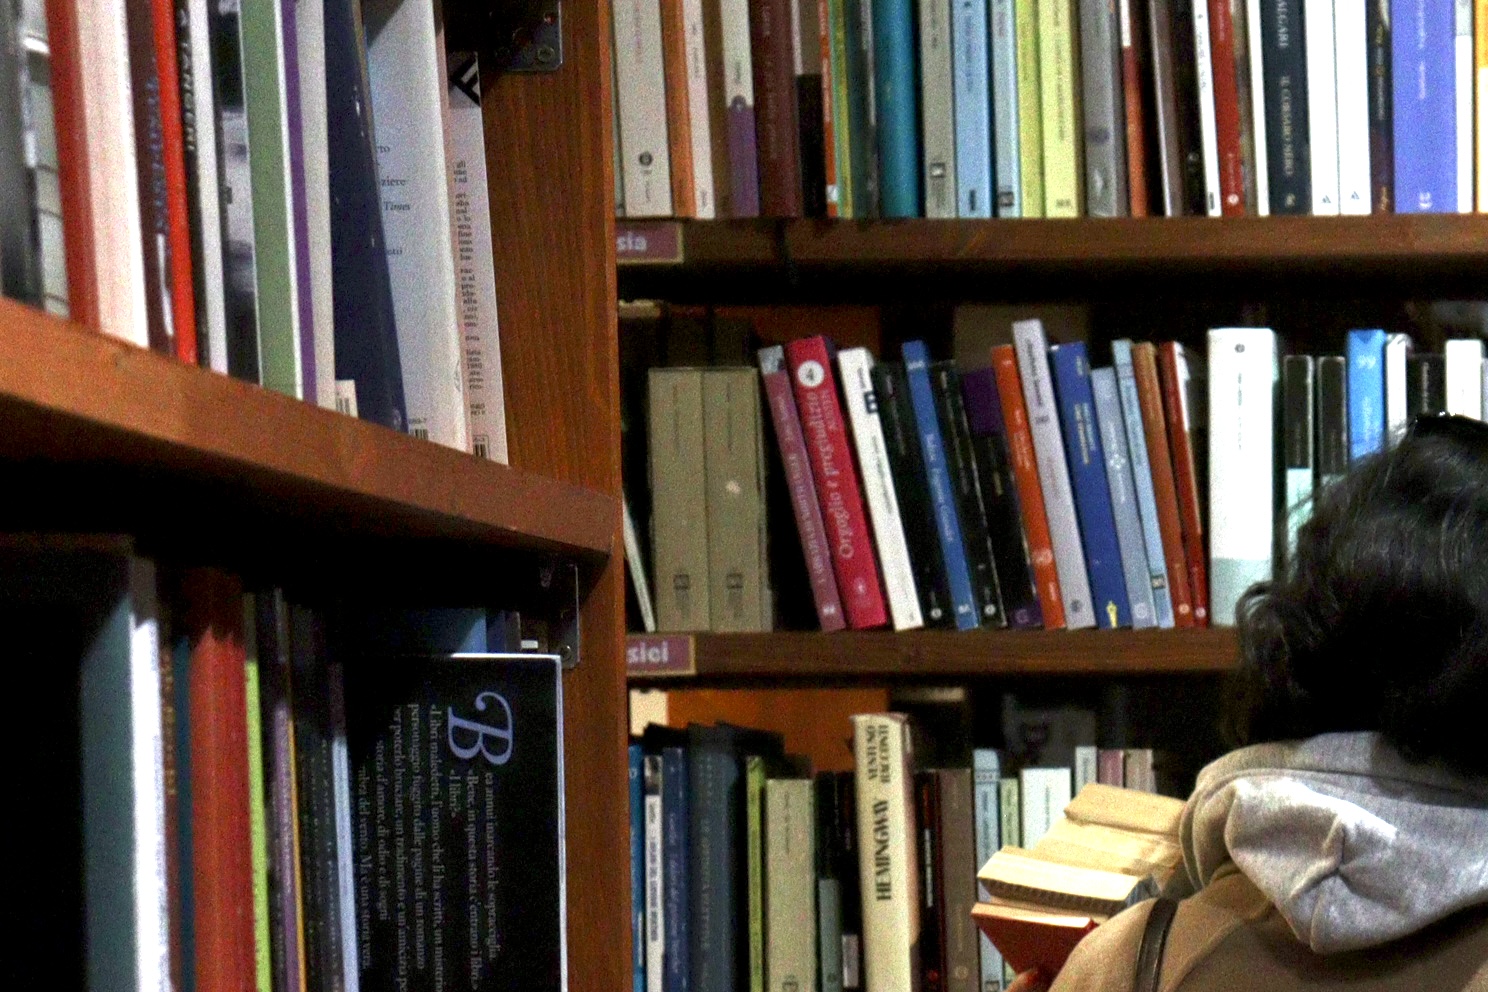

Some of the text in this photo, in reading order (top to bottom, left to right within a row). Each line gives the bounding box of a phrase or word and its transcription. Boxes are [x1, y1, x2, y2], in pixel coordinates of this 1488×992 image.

[1275, 0, 1290, 48] ALGARI
[802, 388, 843, 478] pregiudizio
[825, 490, 857, 560] Orgoglio
[389, 724, 405, 766] poterlo
[448, 691, 514, 766] B
[428, 741, 442, 798] maledetti,
[877, 724, 891, 783] RACCONTI
[376, 825, 389, 837] di
[395, 820, 404, 835] un
[466, 809, 478, 821] in
[377, 839, 389, 864] odio
[406, 703, 426, 969] personaggio fuggito dalle pagine di un romanzo
[431, 841, 444, 862] che
[461, 823, 478, 859] questa
[485, 821, 499, 878] inarcando
[873, 799, 894, 901] HEMINGWAY
[378, 875, 389, 887] di
[395, 836, 408, 900] tradimento
[432, 874, 444, 889] ha
[467, 862, 479, 894] storia
[486, 880, 499, 891] le
[360, 885, 370, 907] una
[431, 891, 444, 927] scritti,
[360, 909, 372, 941] storia
[433, 928, 443, 944] un
